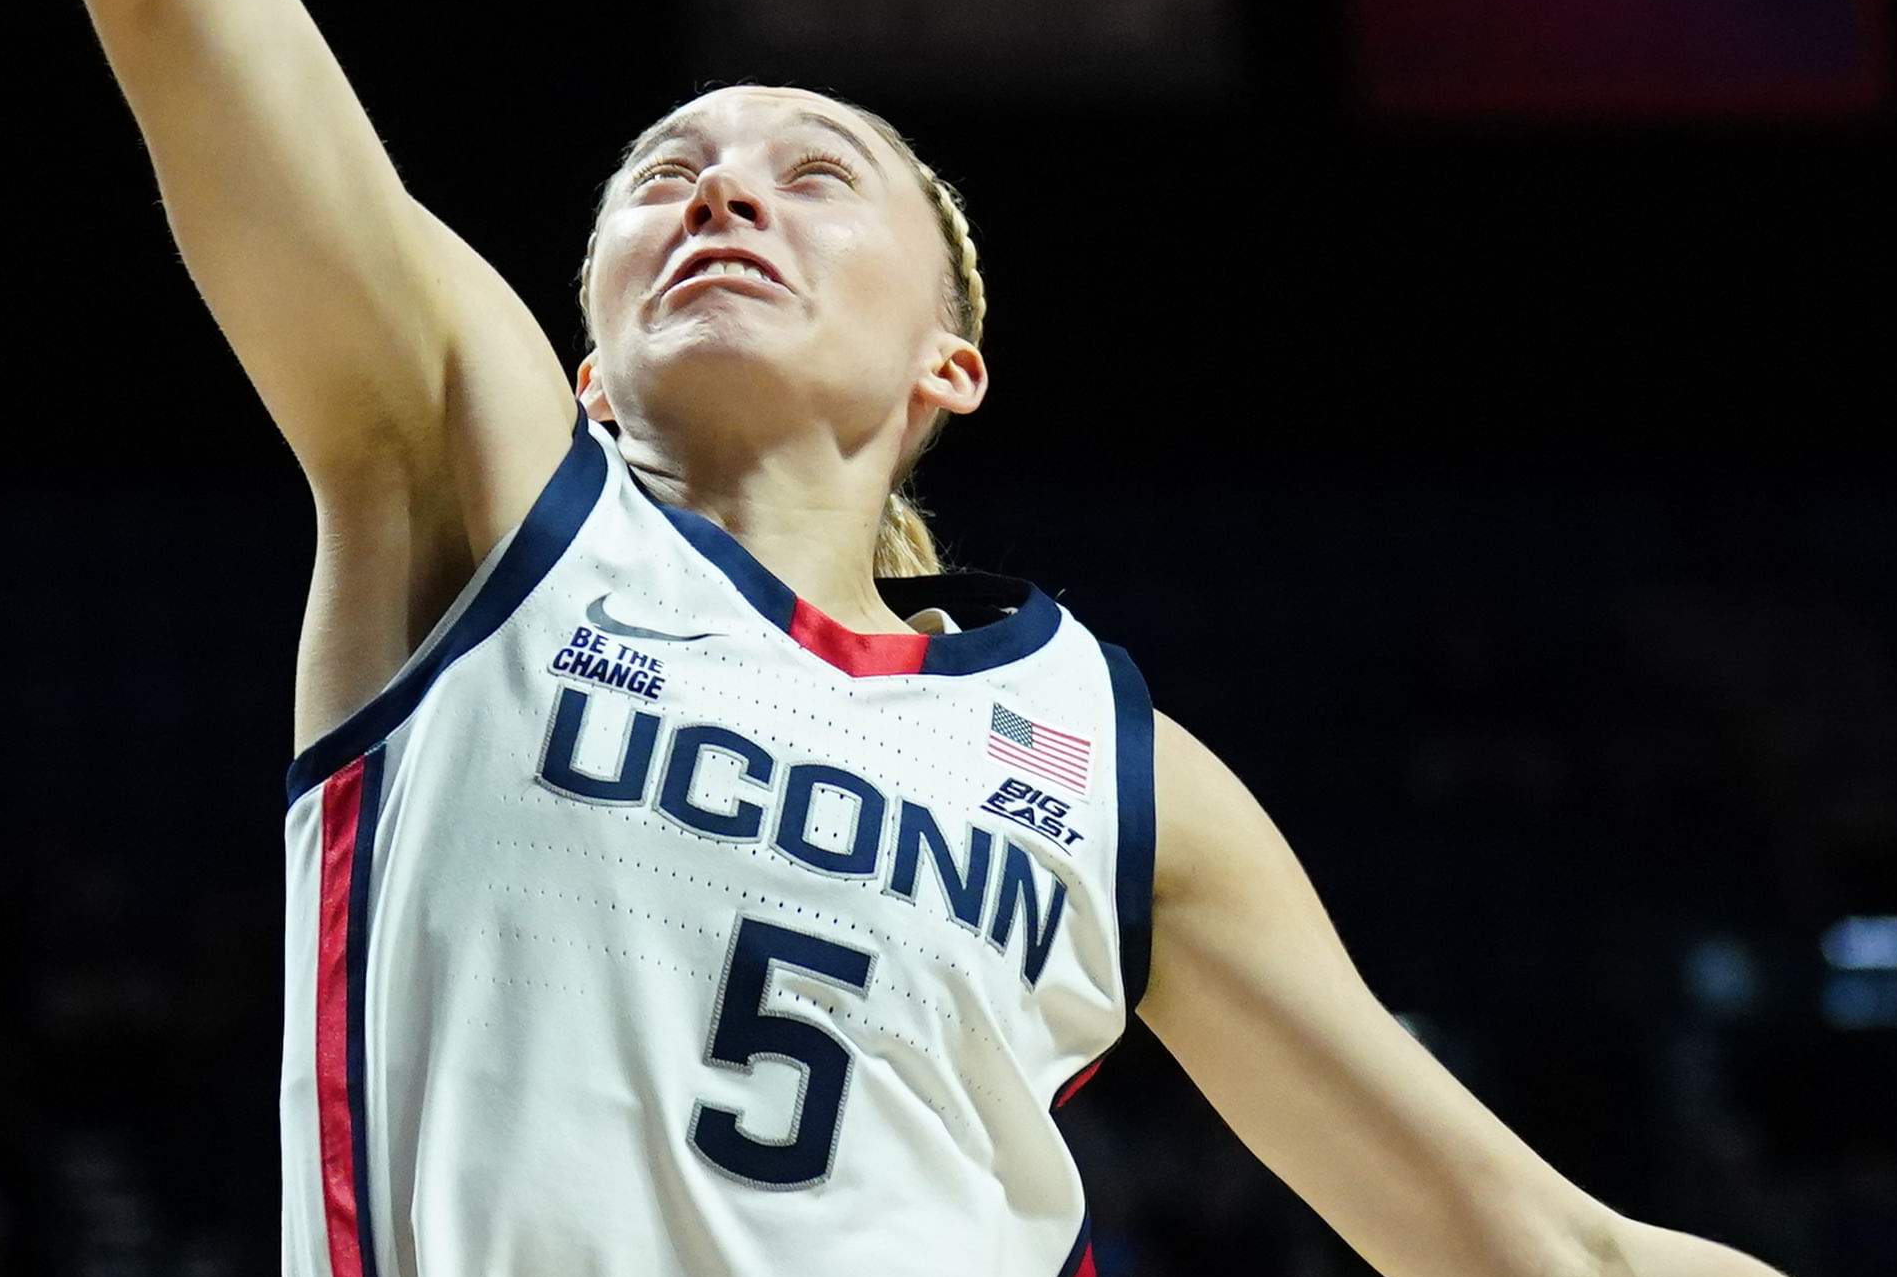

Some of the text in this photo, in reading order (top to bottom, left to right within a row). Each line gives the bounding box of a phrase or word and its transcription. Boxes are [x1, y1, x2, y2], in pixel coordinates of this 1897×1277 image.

[552, 648, 665, 700] CHANGE
[570, 626, 665, 674] BE THE
[985, 791, 1085, 845] EAST
[999, 776, 1072, 819] BIG
[535, 683, 1069, 996] UCONN
[686, 911, 880, 1193] 5
